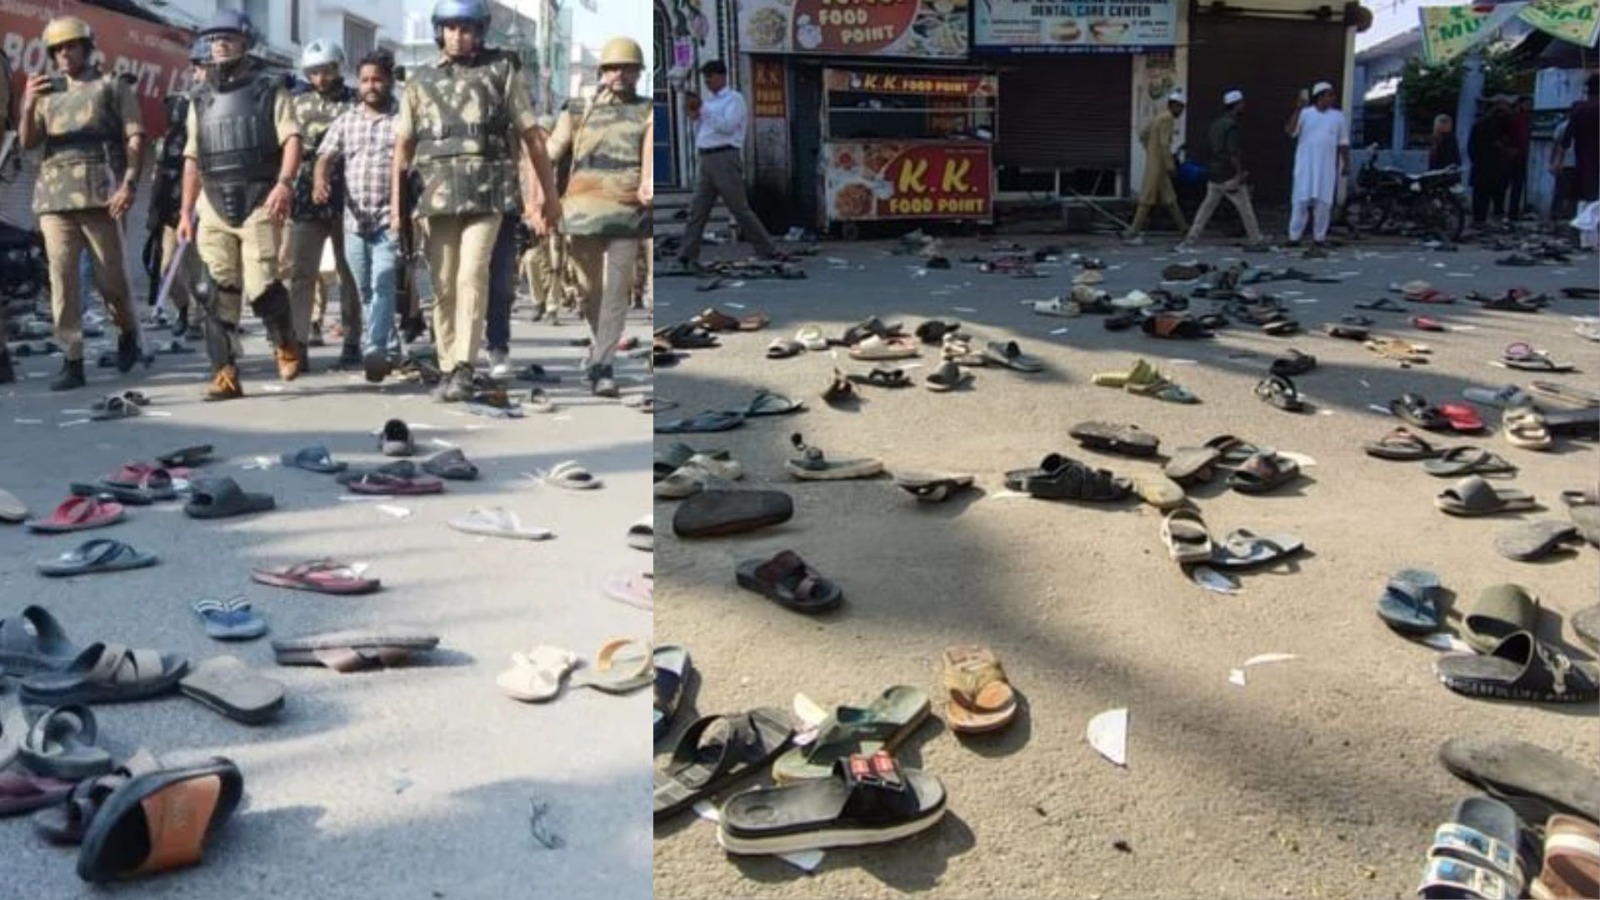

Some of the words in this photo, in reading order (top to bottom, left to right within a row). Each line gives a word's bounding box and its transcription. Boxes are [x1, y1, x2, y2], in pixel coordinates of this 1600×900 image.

[818, 9, 868, 25] FOOD
[1031, 5, 1072, 16] DENTAL
[1077, 5, 1104, 17] CARE
[1109, 6, 1151, 17] CENTER
[840, 25, 895, 44] POINT
[902, 80, 933, 92] FOOD
[935, 81, 969, 93] POINT
[889, 198, 933, 213] FOOD
[937, 198, 985, 213] POINT
